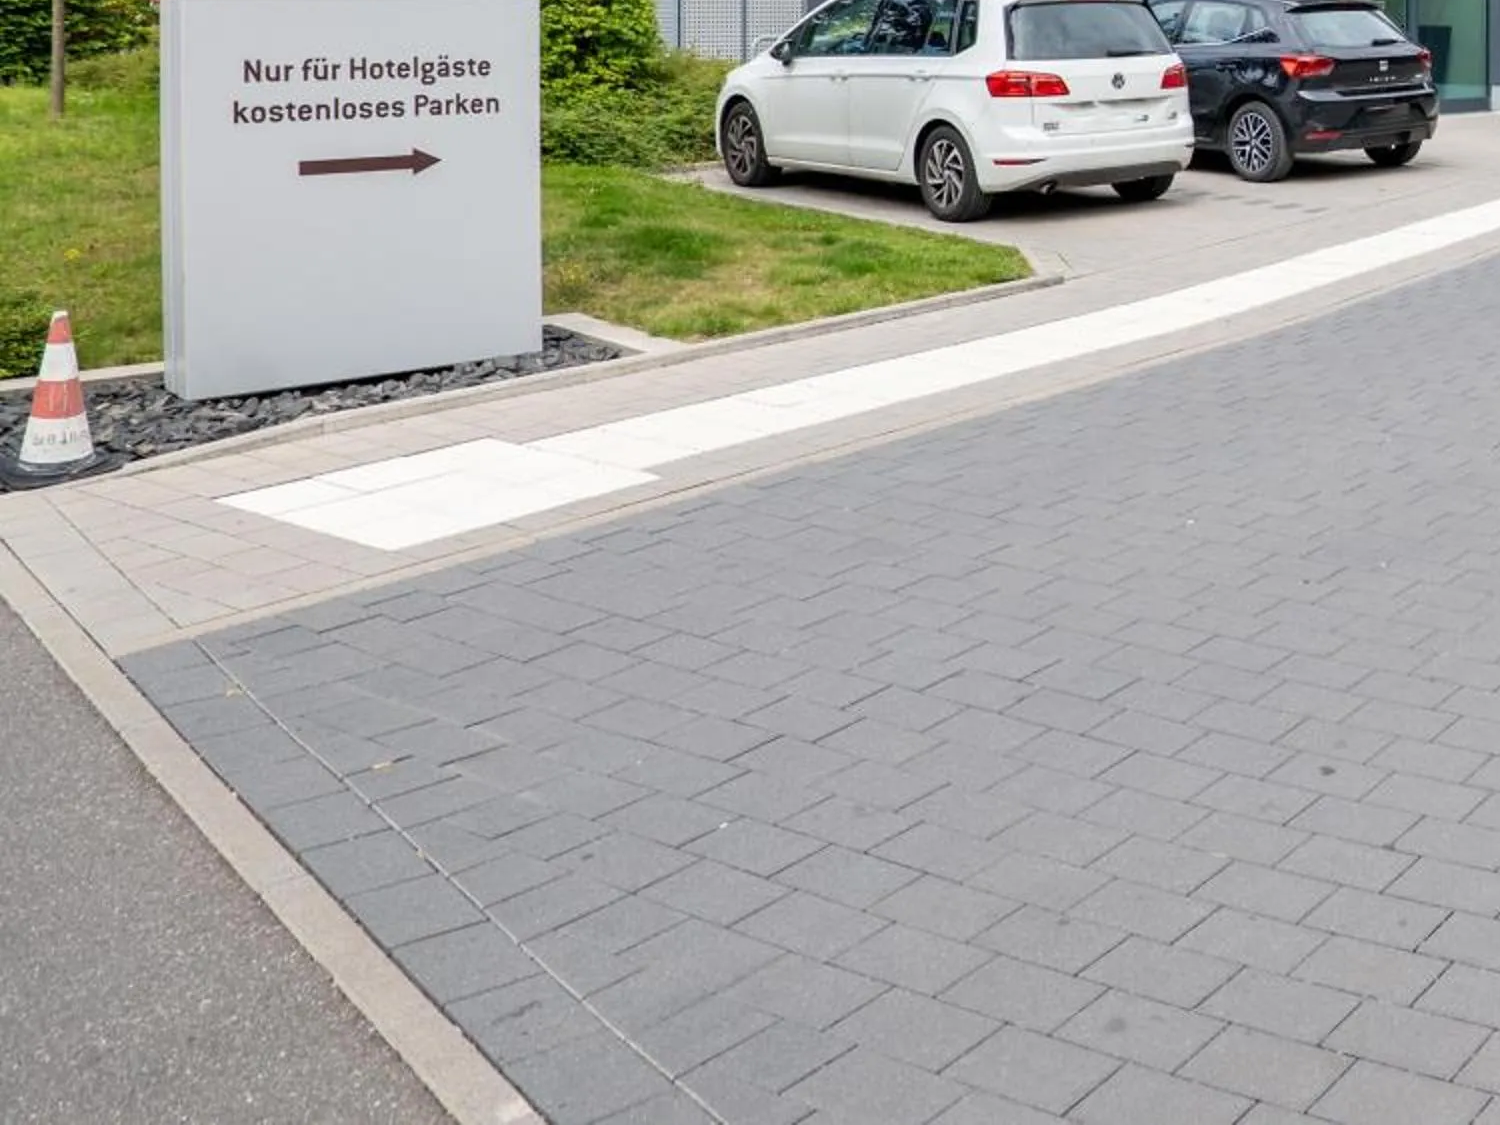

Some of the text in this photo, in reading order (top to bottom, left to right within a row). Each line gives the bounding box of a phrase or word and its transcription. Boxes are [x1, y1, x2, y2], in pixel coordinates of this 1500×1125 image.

[243, 55, 491, 85] Nur für Hotelgäste
[232, 94, 500, 124] kostenloses Parken
